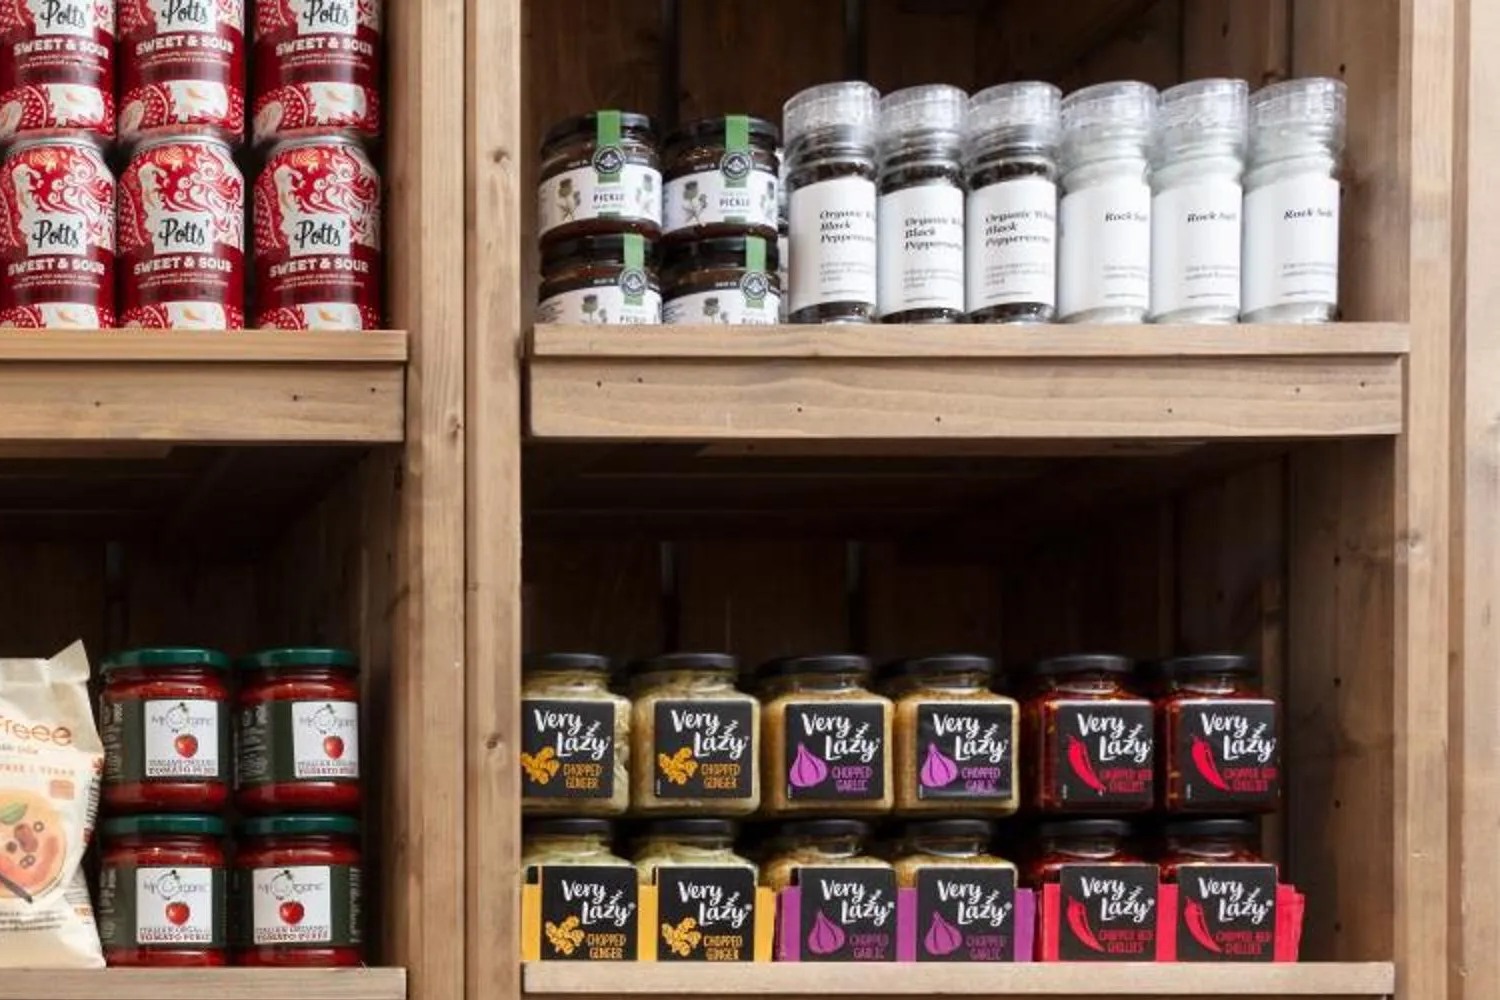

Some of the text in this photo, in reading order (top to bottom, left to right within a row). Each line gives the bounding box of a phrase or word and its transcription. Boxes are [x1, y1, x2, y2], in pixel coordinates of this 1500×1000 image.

[136, 36, 234, 54] SWEET & SOUR
[1105, 211, 1131, 222] Rock
[1187, 212, 1216, 223] Rock
[1284, 208, 1313, 220] Rock
[8, 258, 55, 275] SWEET
[57, 258, 69, 269] &
[134, 257, 232, 275] SWEET & SOUR
[269, 258, 368, 277] SWEET & SOUR
[534, 709, 582, 735] Very
[670, 709, 720, 735] Very
[802, 712, 852, 738] Very
[933, 712, 980, 738] Very
[1077, 713, 1125, 739] Very
[1201, 712, 1249, 739] Very
[556, 730, 610, 761] Lazy
[694, 730, 747, 761] Lazy
[824, 734, 878, 763] Lazy
[955, 734, 1004, 763] Lazy
[1099, 735, 1149, 763] Lazy
[1223, 735, 1273, 763] Lazy
[562, 879, 606, 904] Very
[678, 881, 722, 905] Very
[937, 879, 983, 905] Very
[1198, 877, 1244, 900] Very
[581, 900, 630, 927] Lazy
[699, 901, 748, 928] Lazy
[957, 900, 1005, 927] Lazy
[1219, 897, 1267, 924] Lazy
[139, 931, 181, 941] TOMATO
[256, 932, 295, 941] TOMATO
